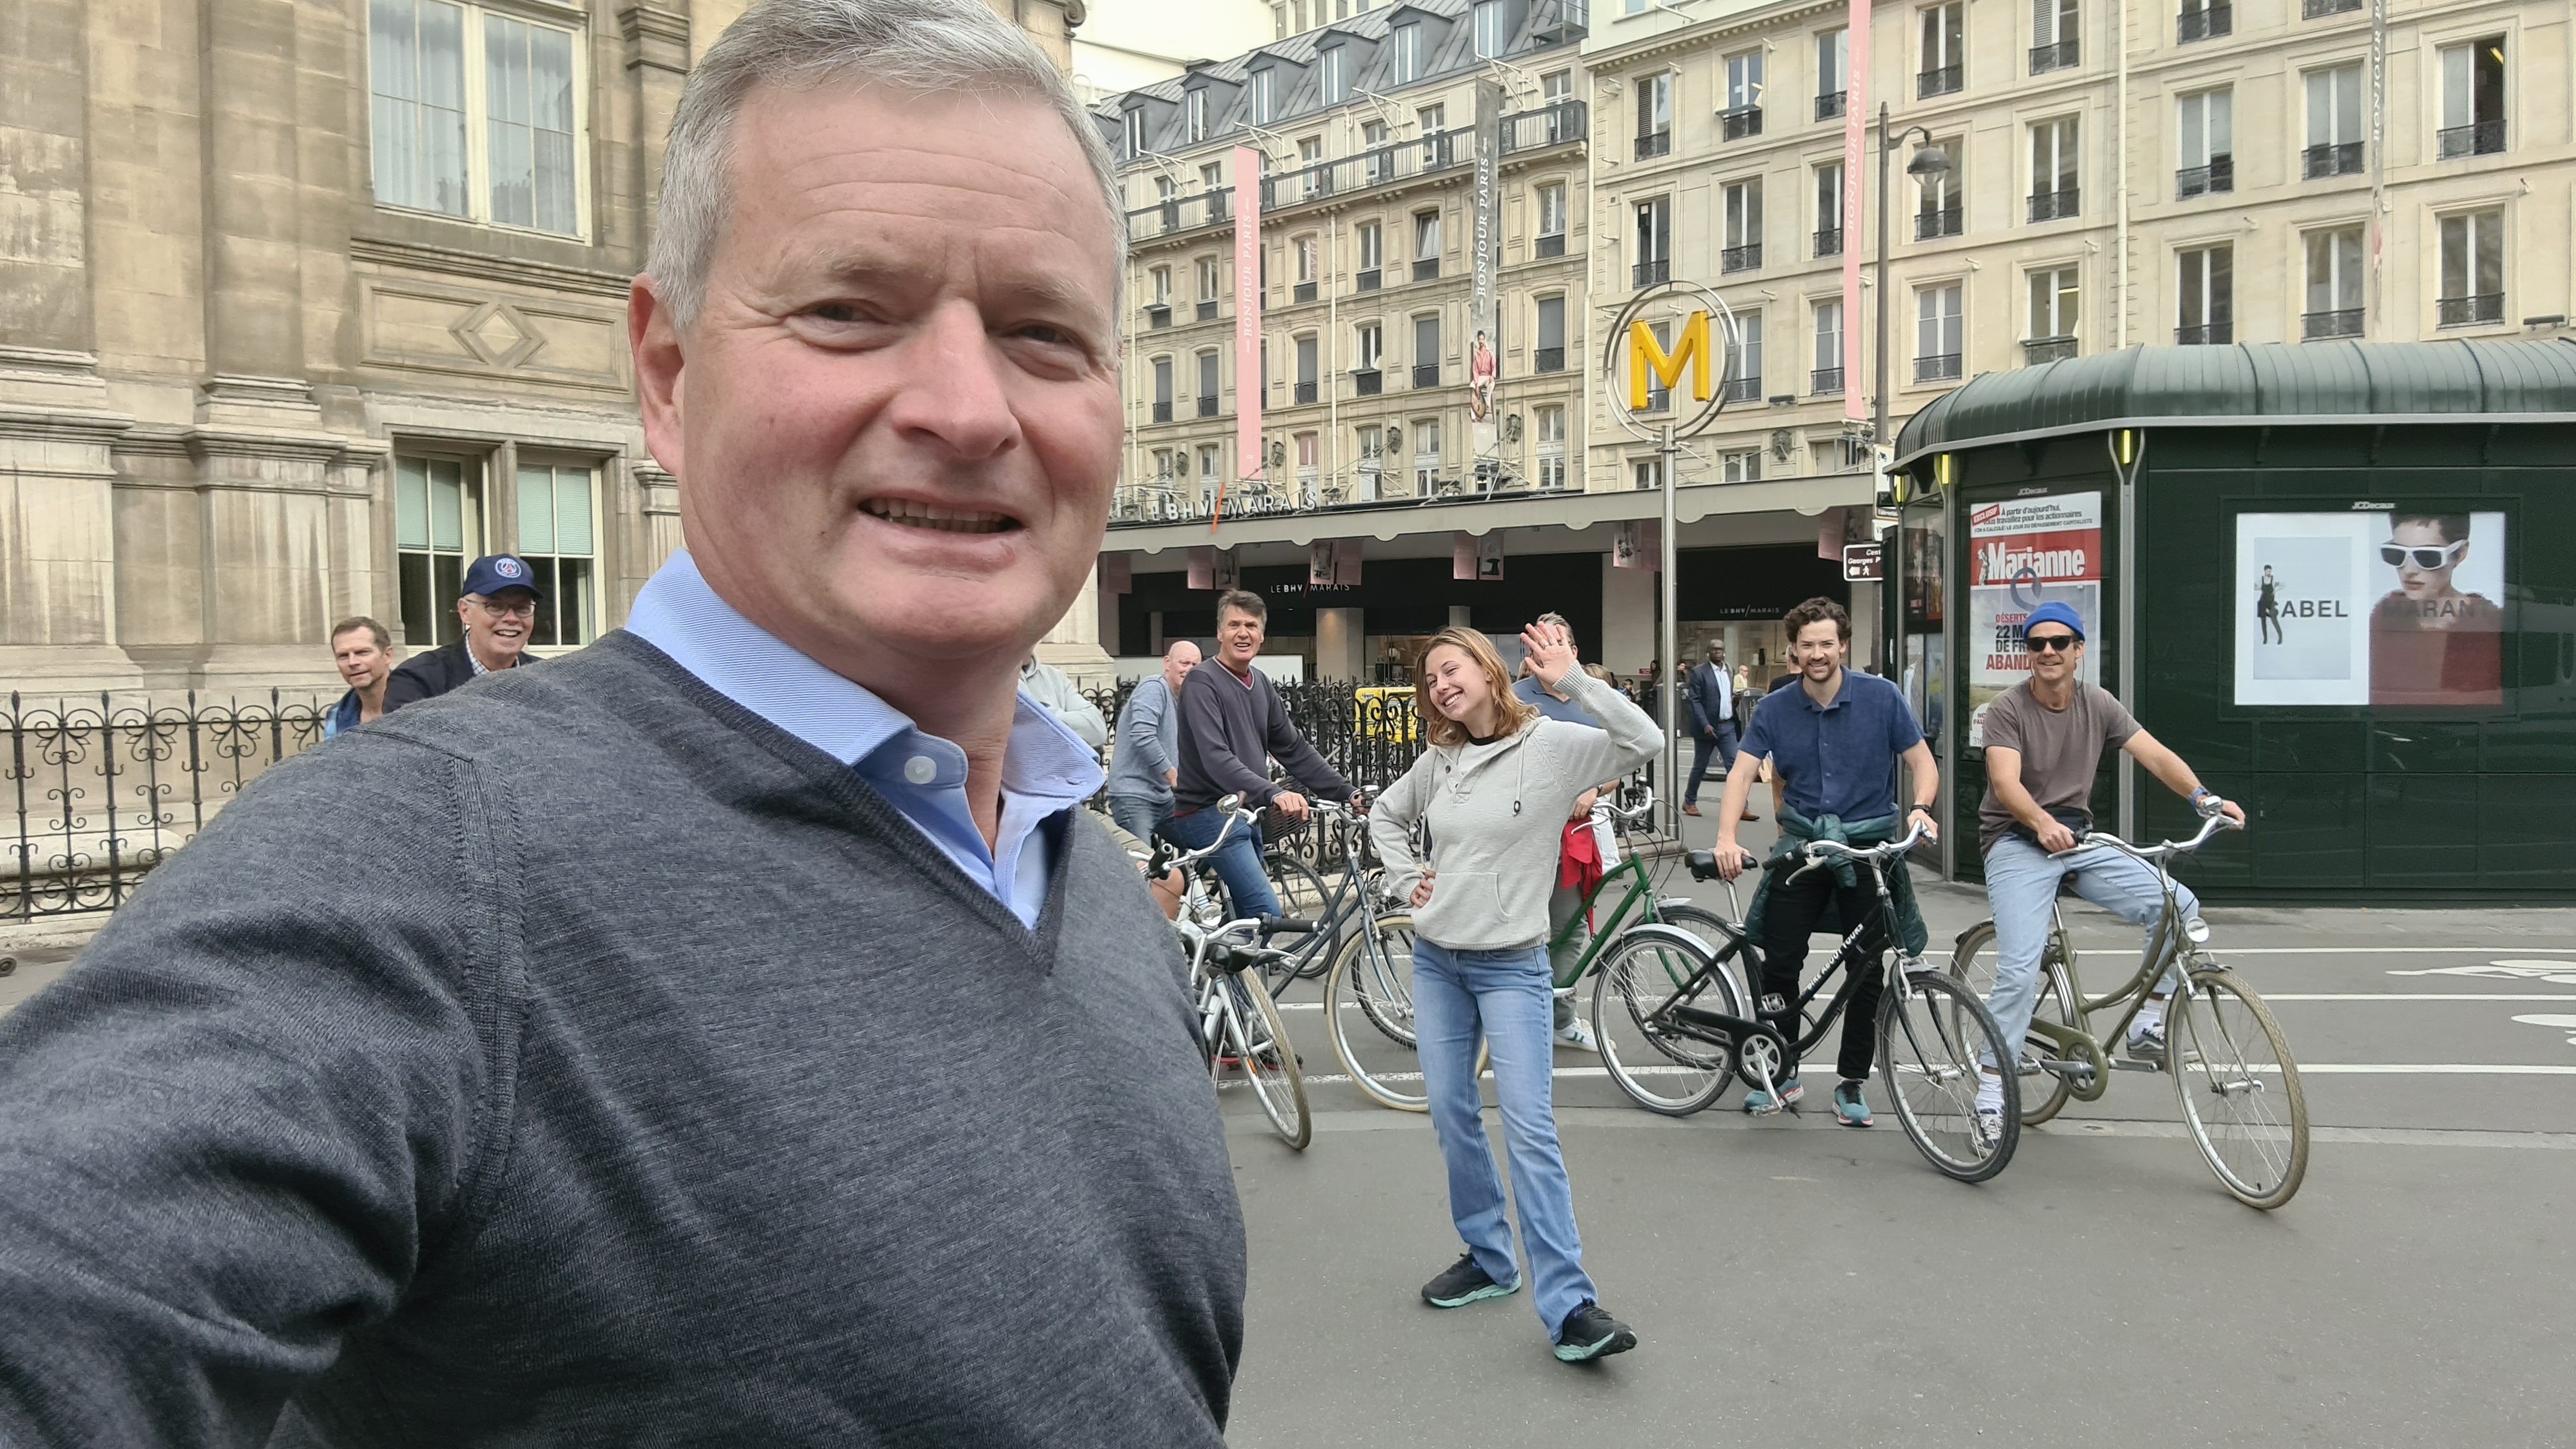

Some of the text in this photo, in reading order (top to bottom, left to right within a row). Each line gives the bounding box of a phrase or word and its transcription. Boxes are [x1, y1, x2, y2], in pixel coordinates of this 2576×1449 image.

[1848, 69, 1861, 231] BONJOUR PARIS
[1477, 158, 1489, 297] BONJOUR PARIS
[1243, 215, 1254, 338] BONJOUR PARIS
[1629, 309, 1711, 410] M
[2007, 508, 2022, 517] partir
[2352, 501, 2396, 510] JCDecaux
[2046, 510, 2083, 520] actionnaires
[1848, 557, 1873, 565] Georges
[1987, 542, 2086, 580] Marianne
[1270, 585, 1282, 593] LE
[1996, 612, 2027, 623] DÉSERTS
[1996, 625, 2011, 639] 22
[1996, 639, 2025, 652] DE FR
[1985, 654, 2031, 670] ABAND
[1806, 922, 1864, 991] BIKE ABOUT TOURS
